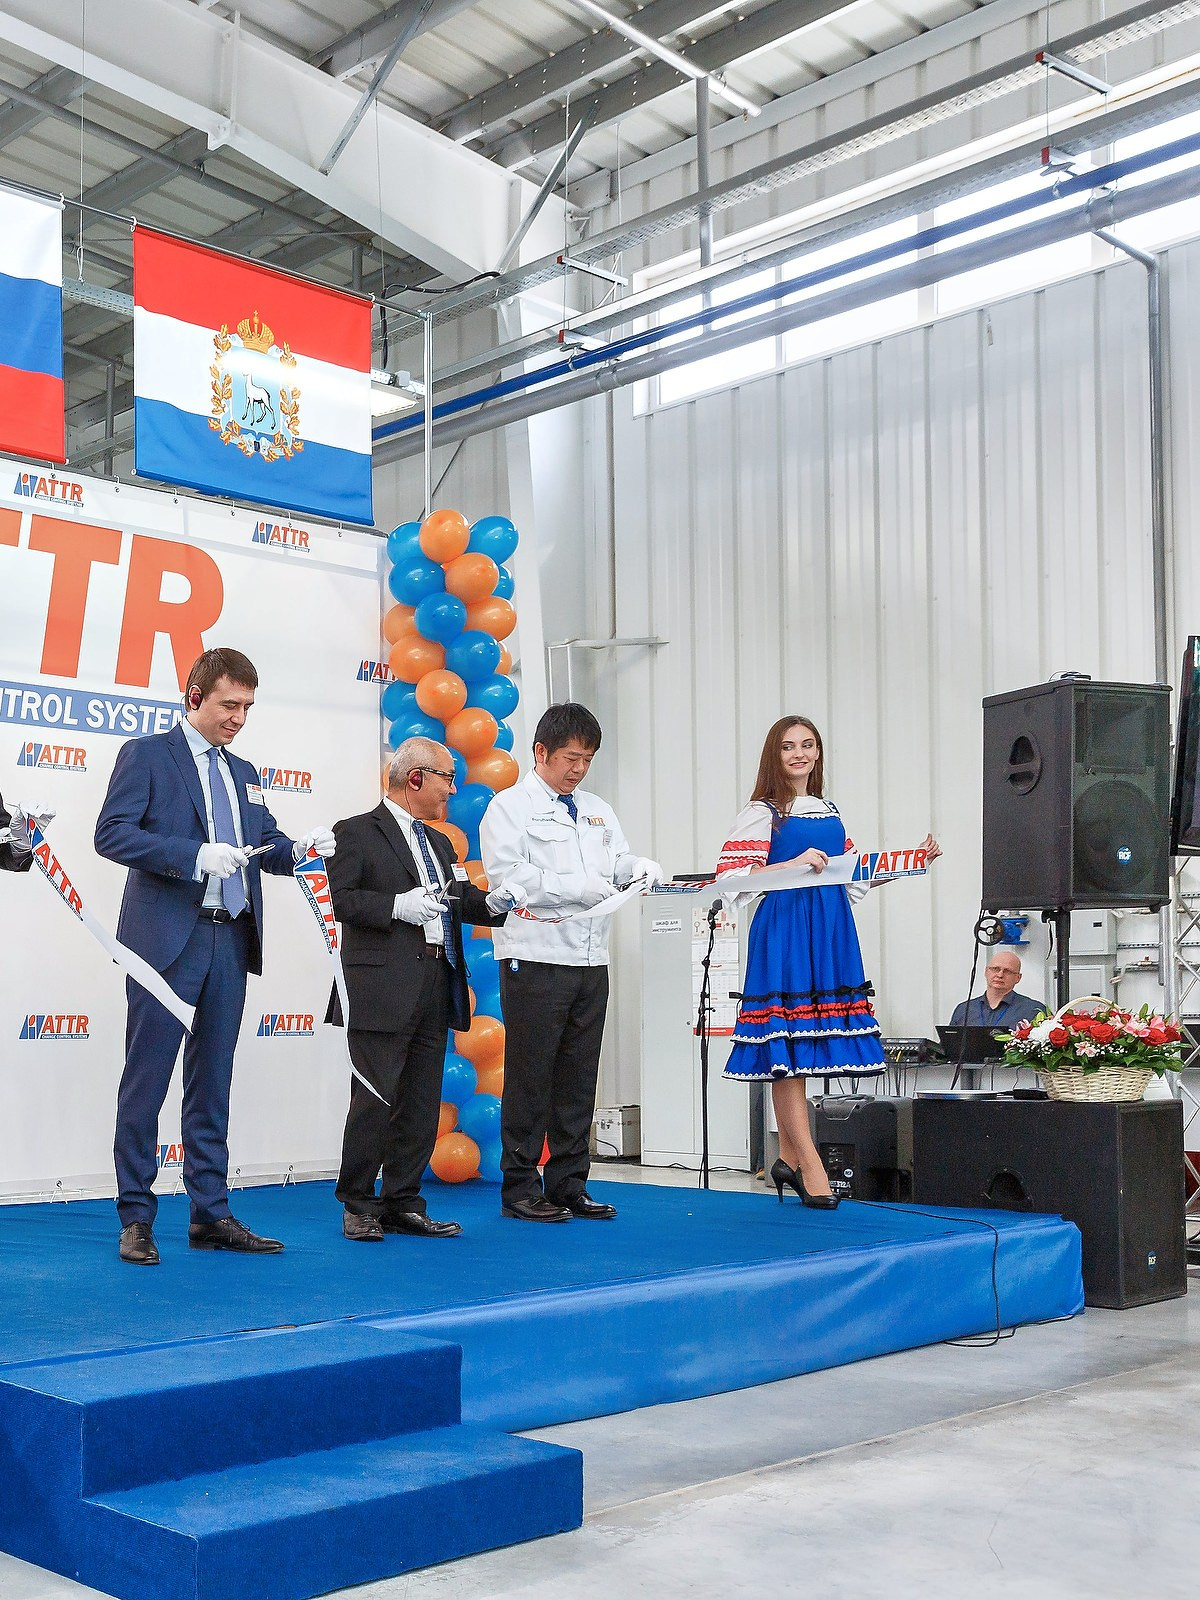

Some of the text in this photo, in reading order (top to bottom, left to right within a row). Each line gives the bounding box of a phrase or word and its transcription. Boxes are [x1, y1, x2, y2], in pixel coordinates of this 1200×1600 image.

[36, 477, 84, 502] ATTR
[270, 525, 310, 548] ATTR
[85, 697, 182, 735] SYSTE
[39, 744, 87, 766] ATTR
[273, 769, 311, 788] ATTR
[876, 849, 927, 873] ATTR
[36, 843, 83, 914] ATTR
[41, 1015, 89, 1033] ATTR
[275, 1014, 314, 1031] ATTR
